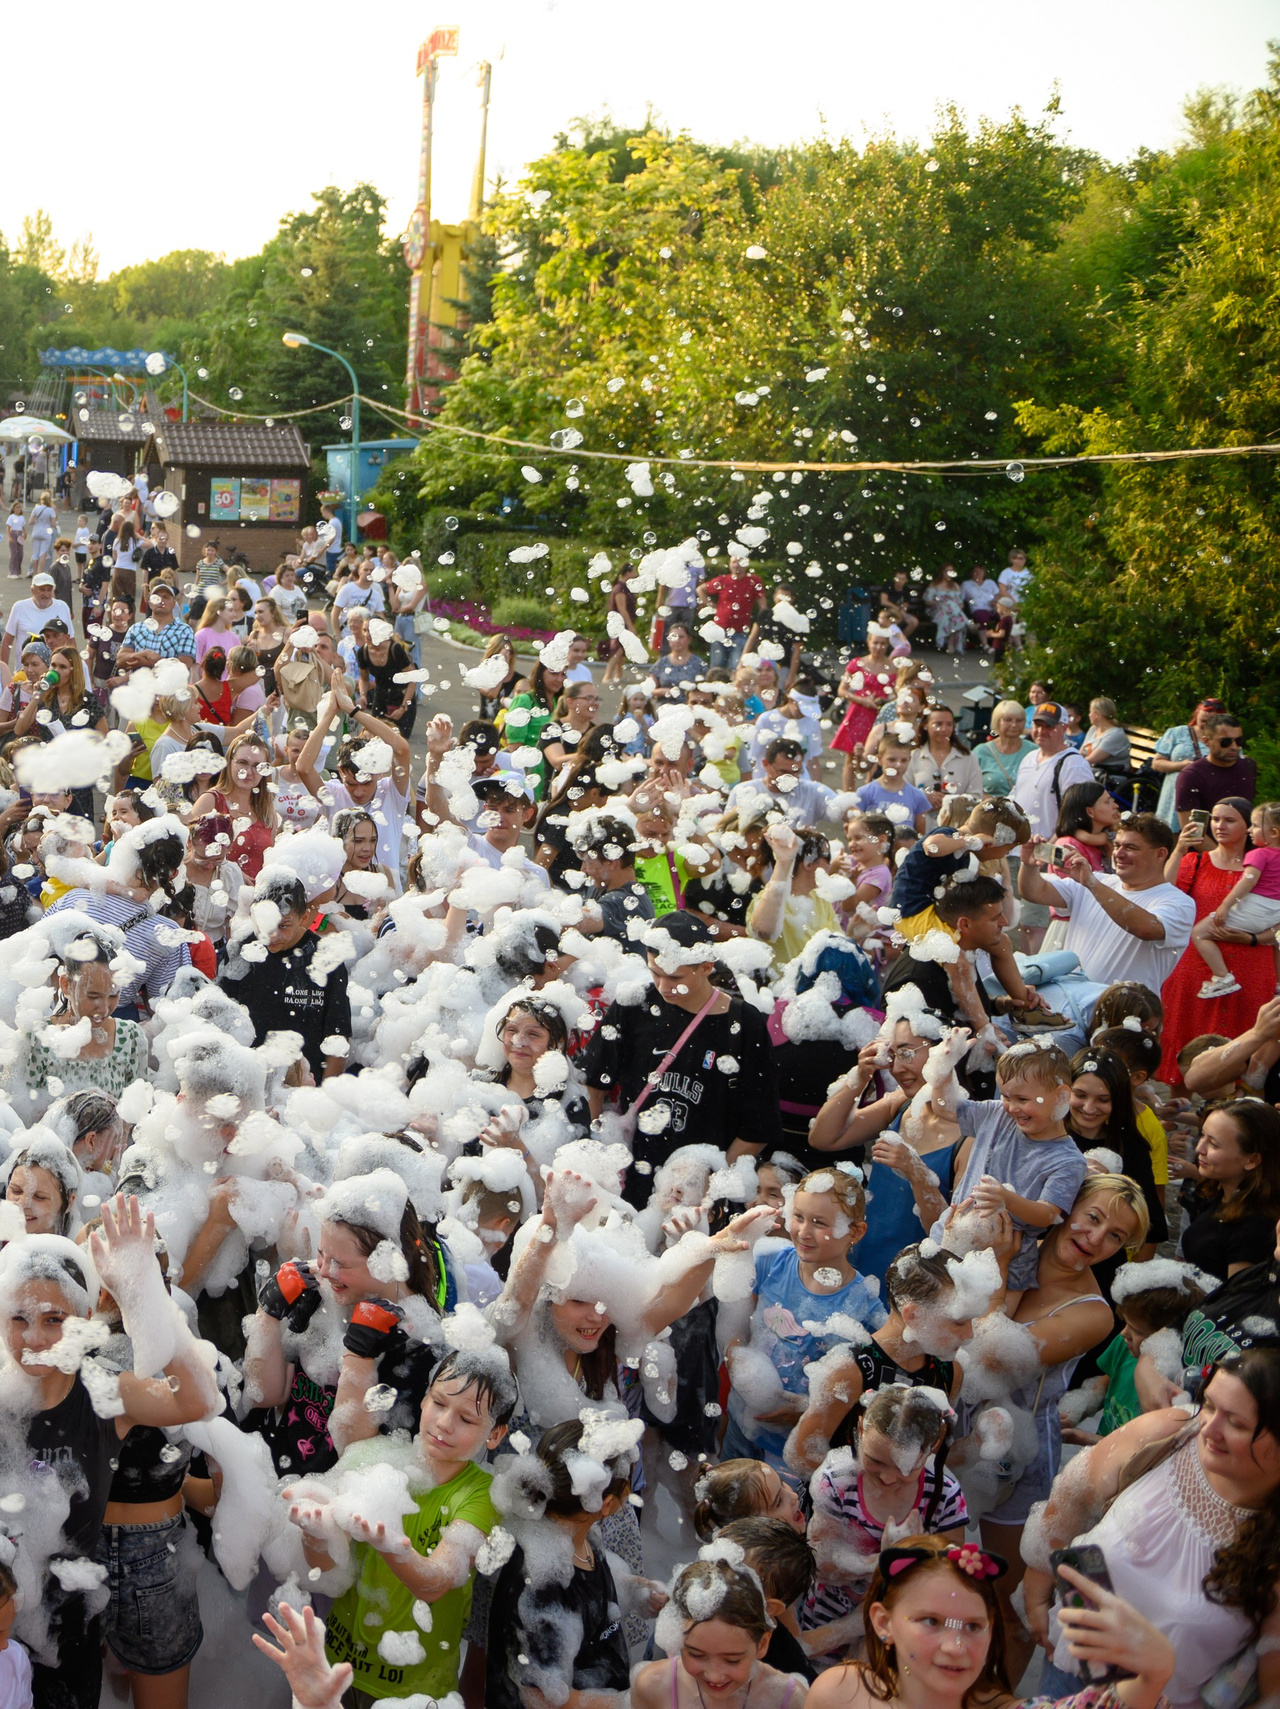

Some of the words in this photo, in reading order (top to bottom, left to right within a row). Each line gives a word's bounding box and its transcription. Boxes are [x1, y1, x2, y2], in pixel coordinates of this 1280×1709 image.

[325, 1628, 345, 1656] RCE
[343, 1652, 373, 1673] FAIT
[378, 1665, 404, 1684] LOI
